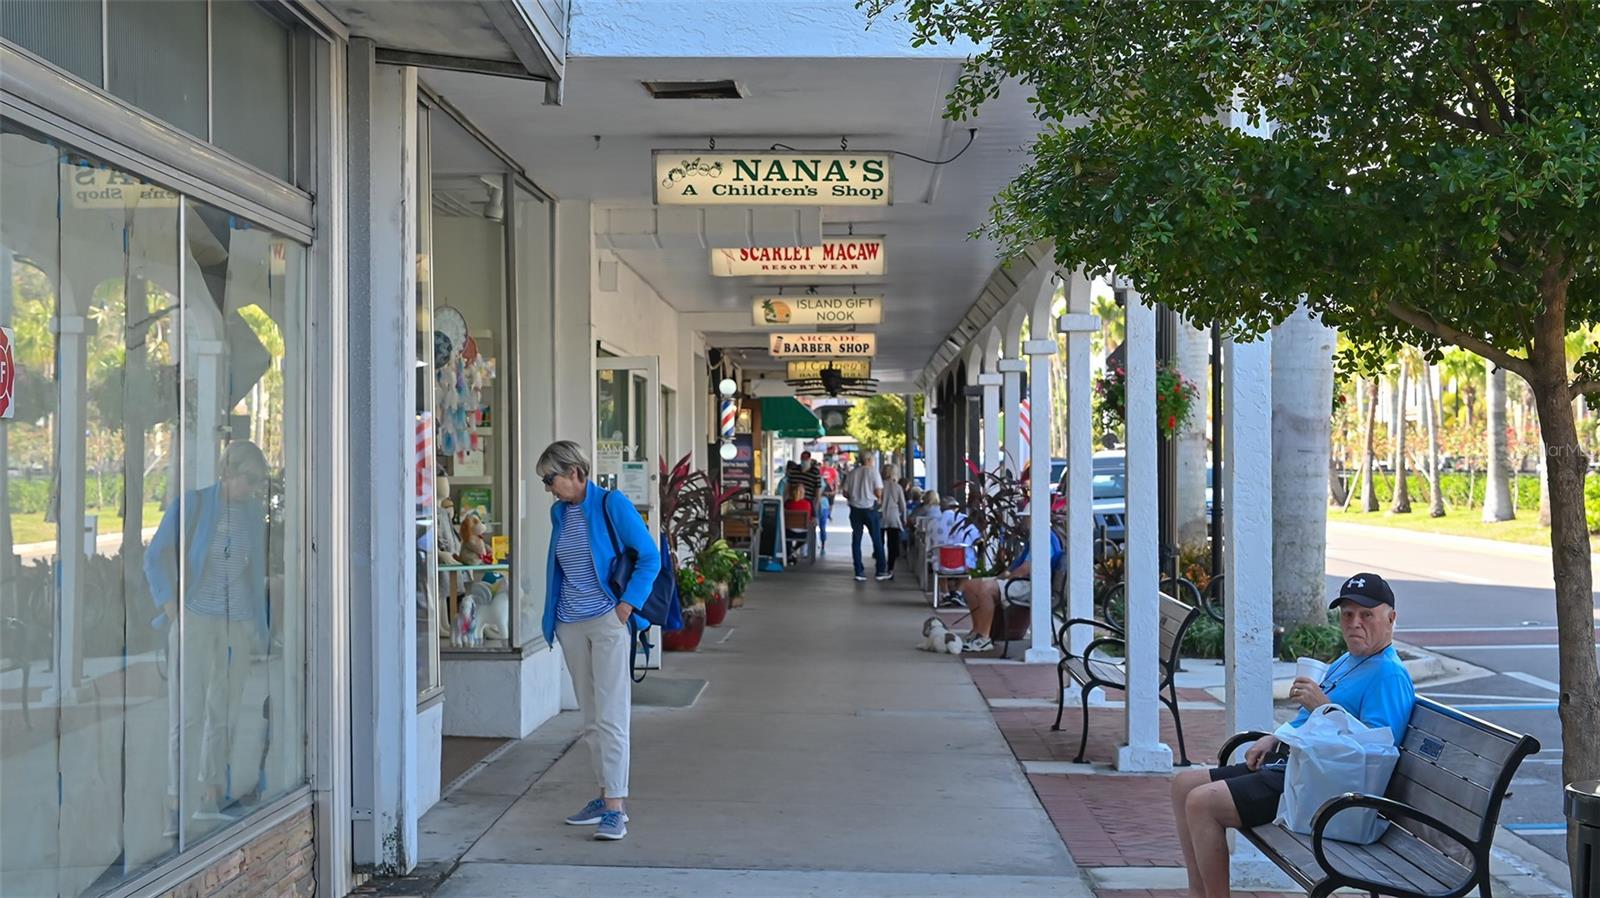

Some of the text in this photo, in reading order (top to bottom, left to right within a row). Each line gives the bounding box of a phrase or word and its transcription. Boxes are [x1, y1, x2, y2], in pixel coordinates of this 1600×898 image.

[732, 159, 884, 182] NANA'S
[681, 184, 884, 199] A Children's Shop
[740, 243, 880, 261] SCARLET MACAW
[796, 298, 874, 309] ISLAND GIFT
[816, 311, 855, 321] NOOK
[784, 343, 870, 353] BARBER SHOP
